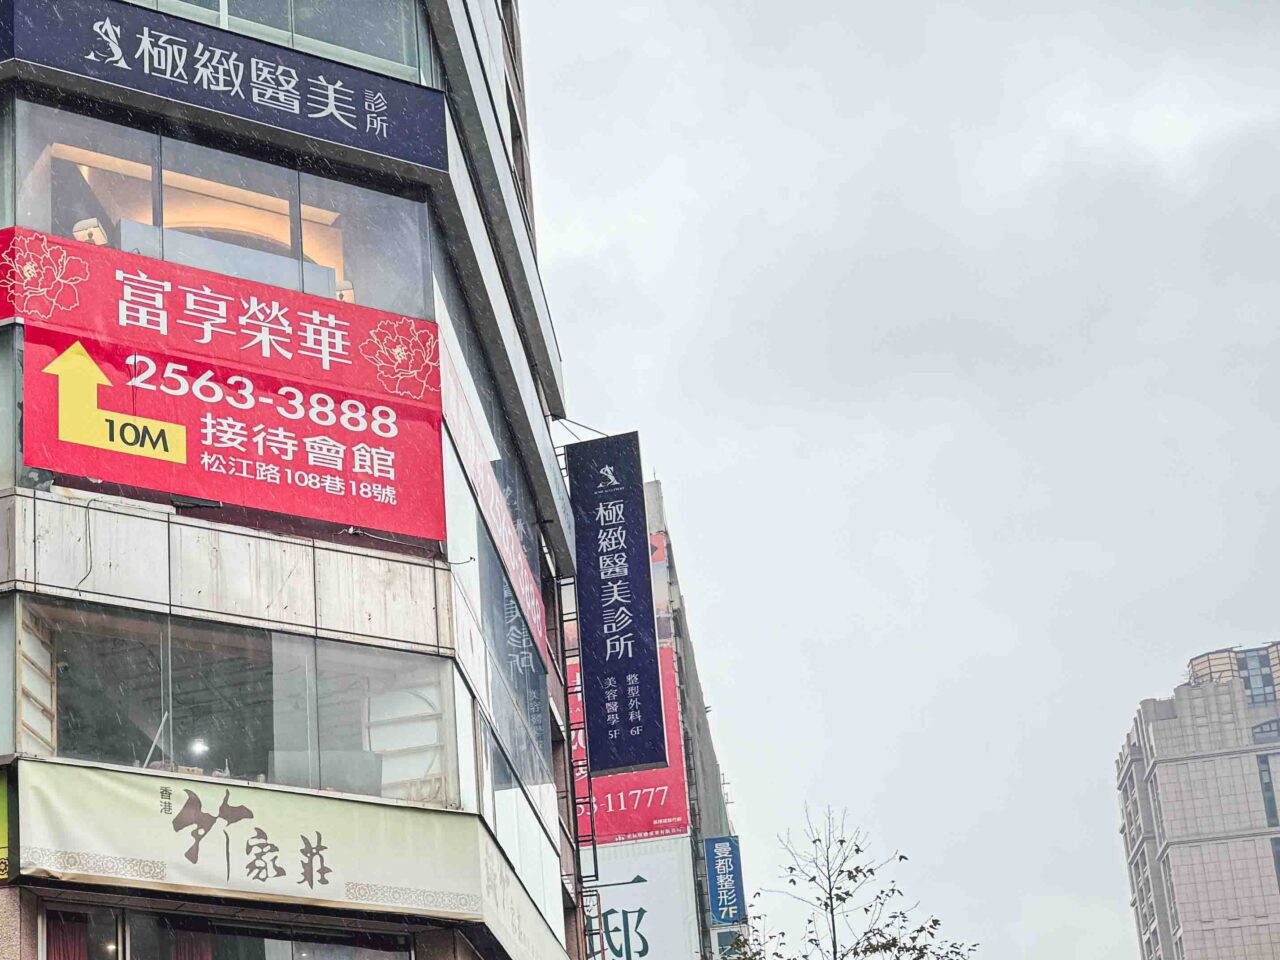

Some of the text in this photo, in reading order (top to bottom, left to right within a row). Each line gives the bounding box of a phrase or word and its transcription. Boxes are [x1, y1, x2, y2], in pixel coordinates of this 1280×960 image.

[133, 26, 358, 131] 極緻醫美
[363, 88, 389, 139] 診所
[115, 269, 354, 372] 富享榮華
[123, 353, 400, 439] 2563-3888
[104, 418, 170, 453] 10M
[199, 412, 396, 481] 接待會館
[199, 451, 398, 506] 松江路108巷18號
[595, 499, 634, 660] 極緻醫美診所
[604, 676, 620, 726] 美容醫學
[625, 673, 642, 722] 整型外科
[608, 728, 620, 739] 5F
[630, 725, 643, 736] 6F
[159, 785, 173, 815] 香港
[713, 842, 738, 906] 曼都整形
[719, 907, 738, 919] 7F
